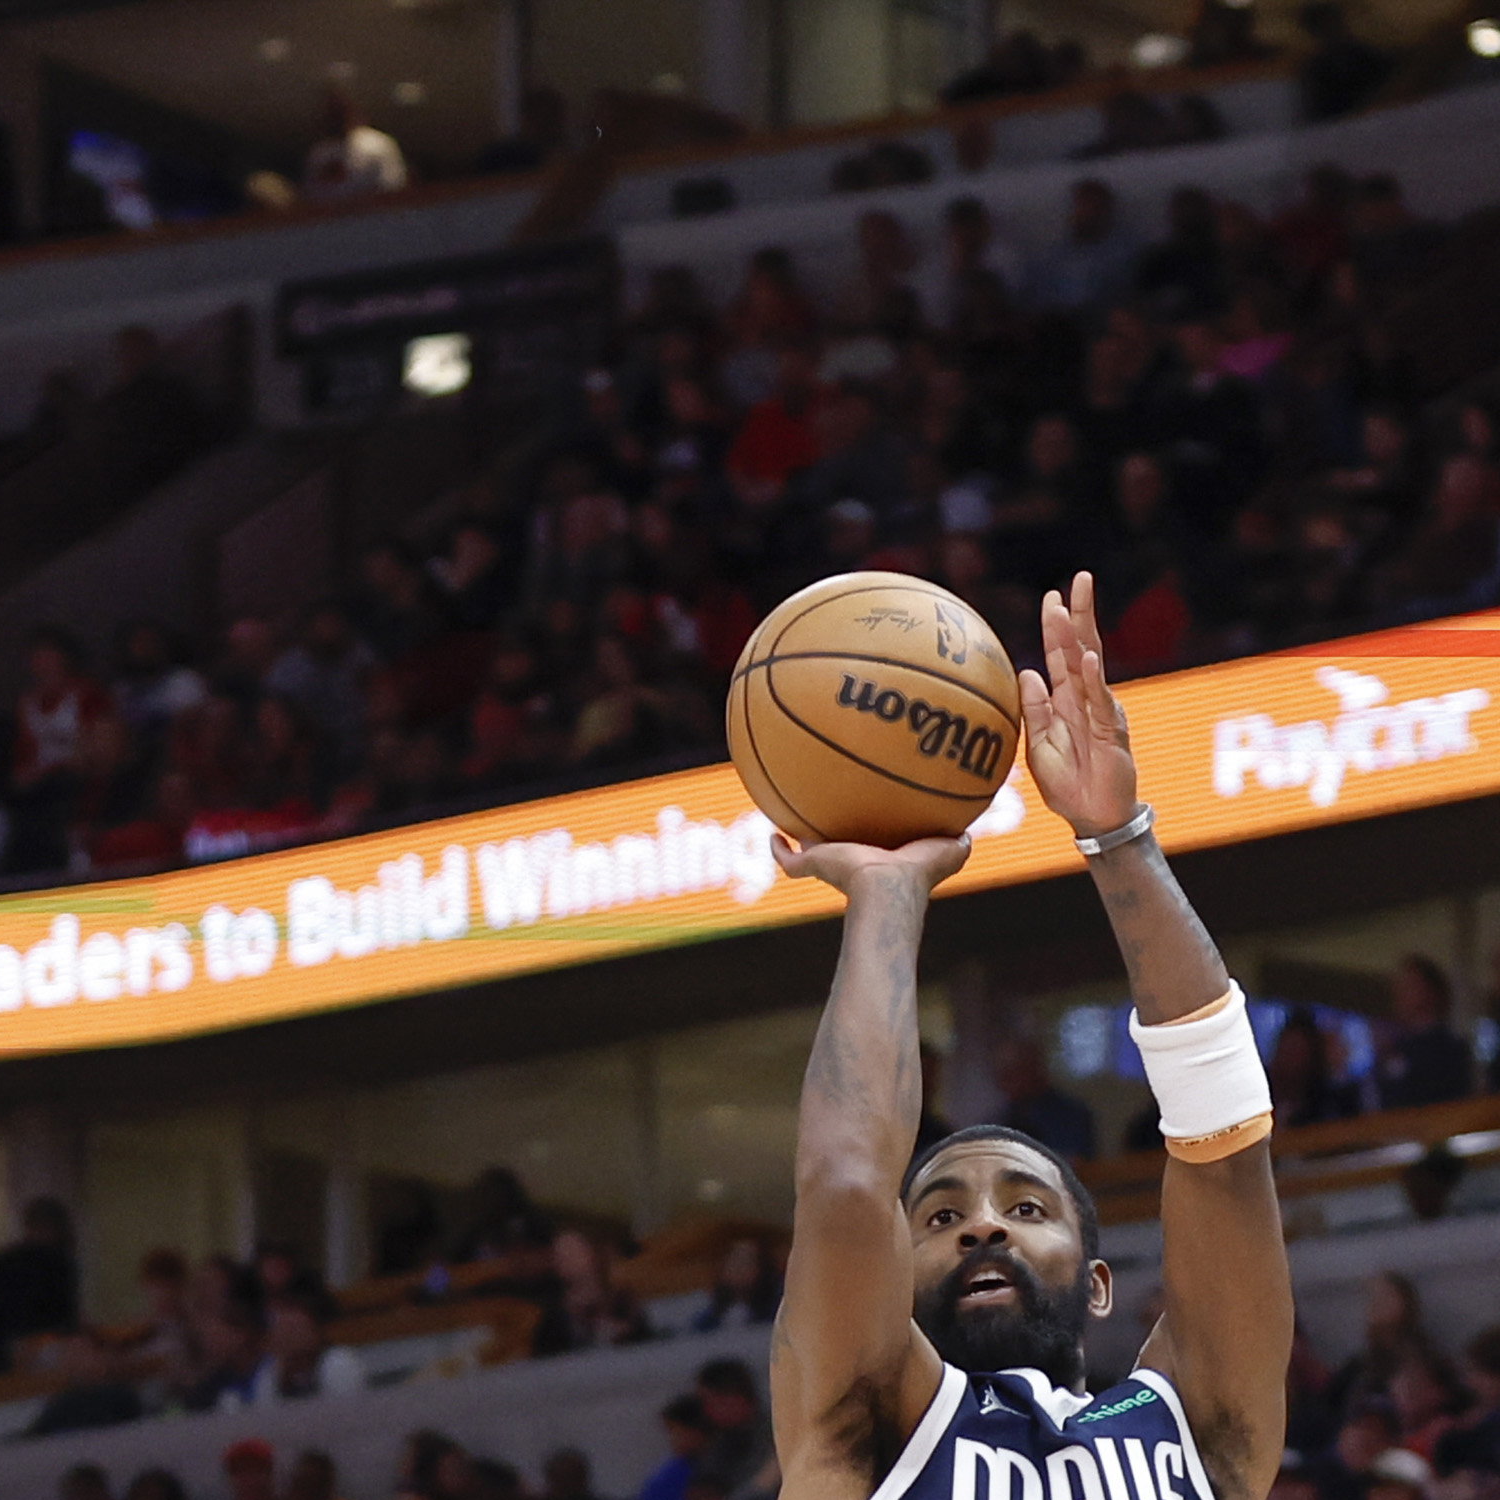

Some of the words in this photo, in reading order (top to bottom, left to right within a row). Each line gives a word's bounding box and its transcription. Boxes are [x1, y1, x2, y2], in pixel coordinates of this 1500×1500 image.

[837, 671, 1003, 781] Wilson
[1212, 686, 1491, 808] Paycor
[199, 905, 278, 983] to
[287, 844, 471, 966] Build
[475, 805, 777, 931] Winning
[1077, 1390, 1158, 1423] chime
